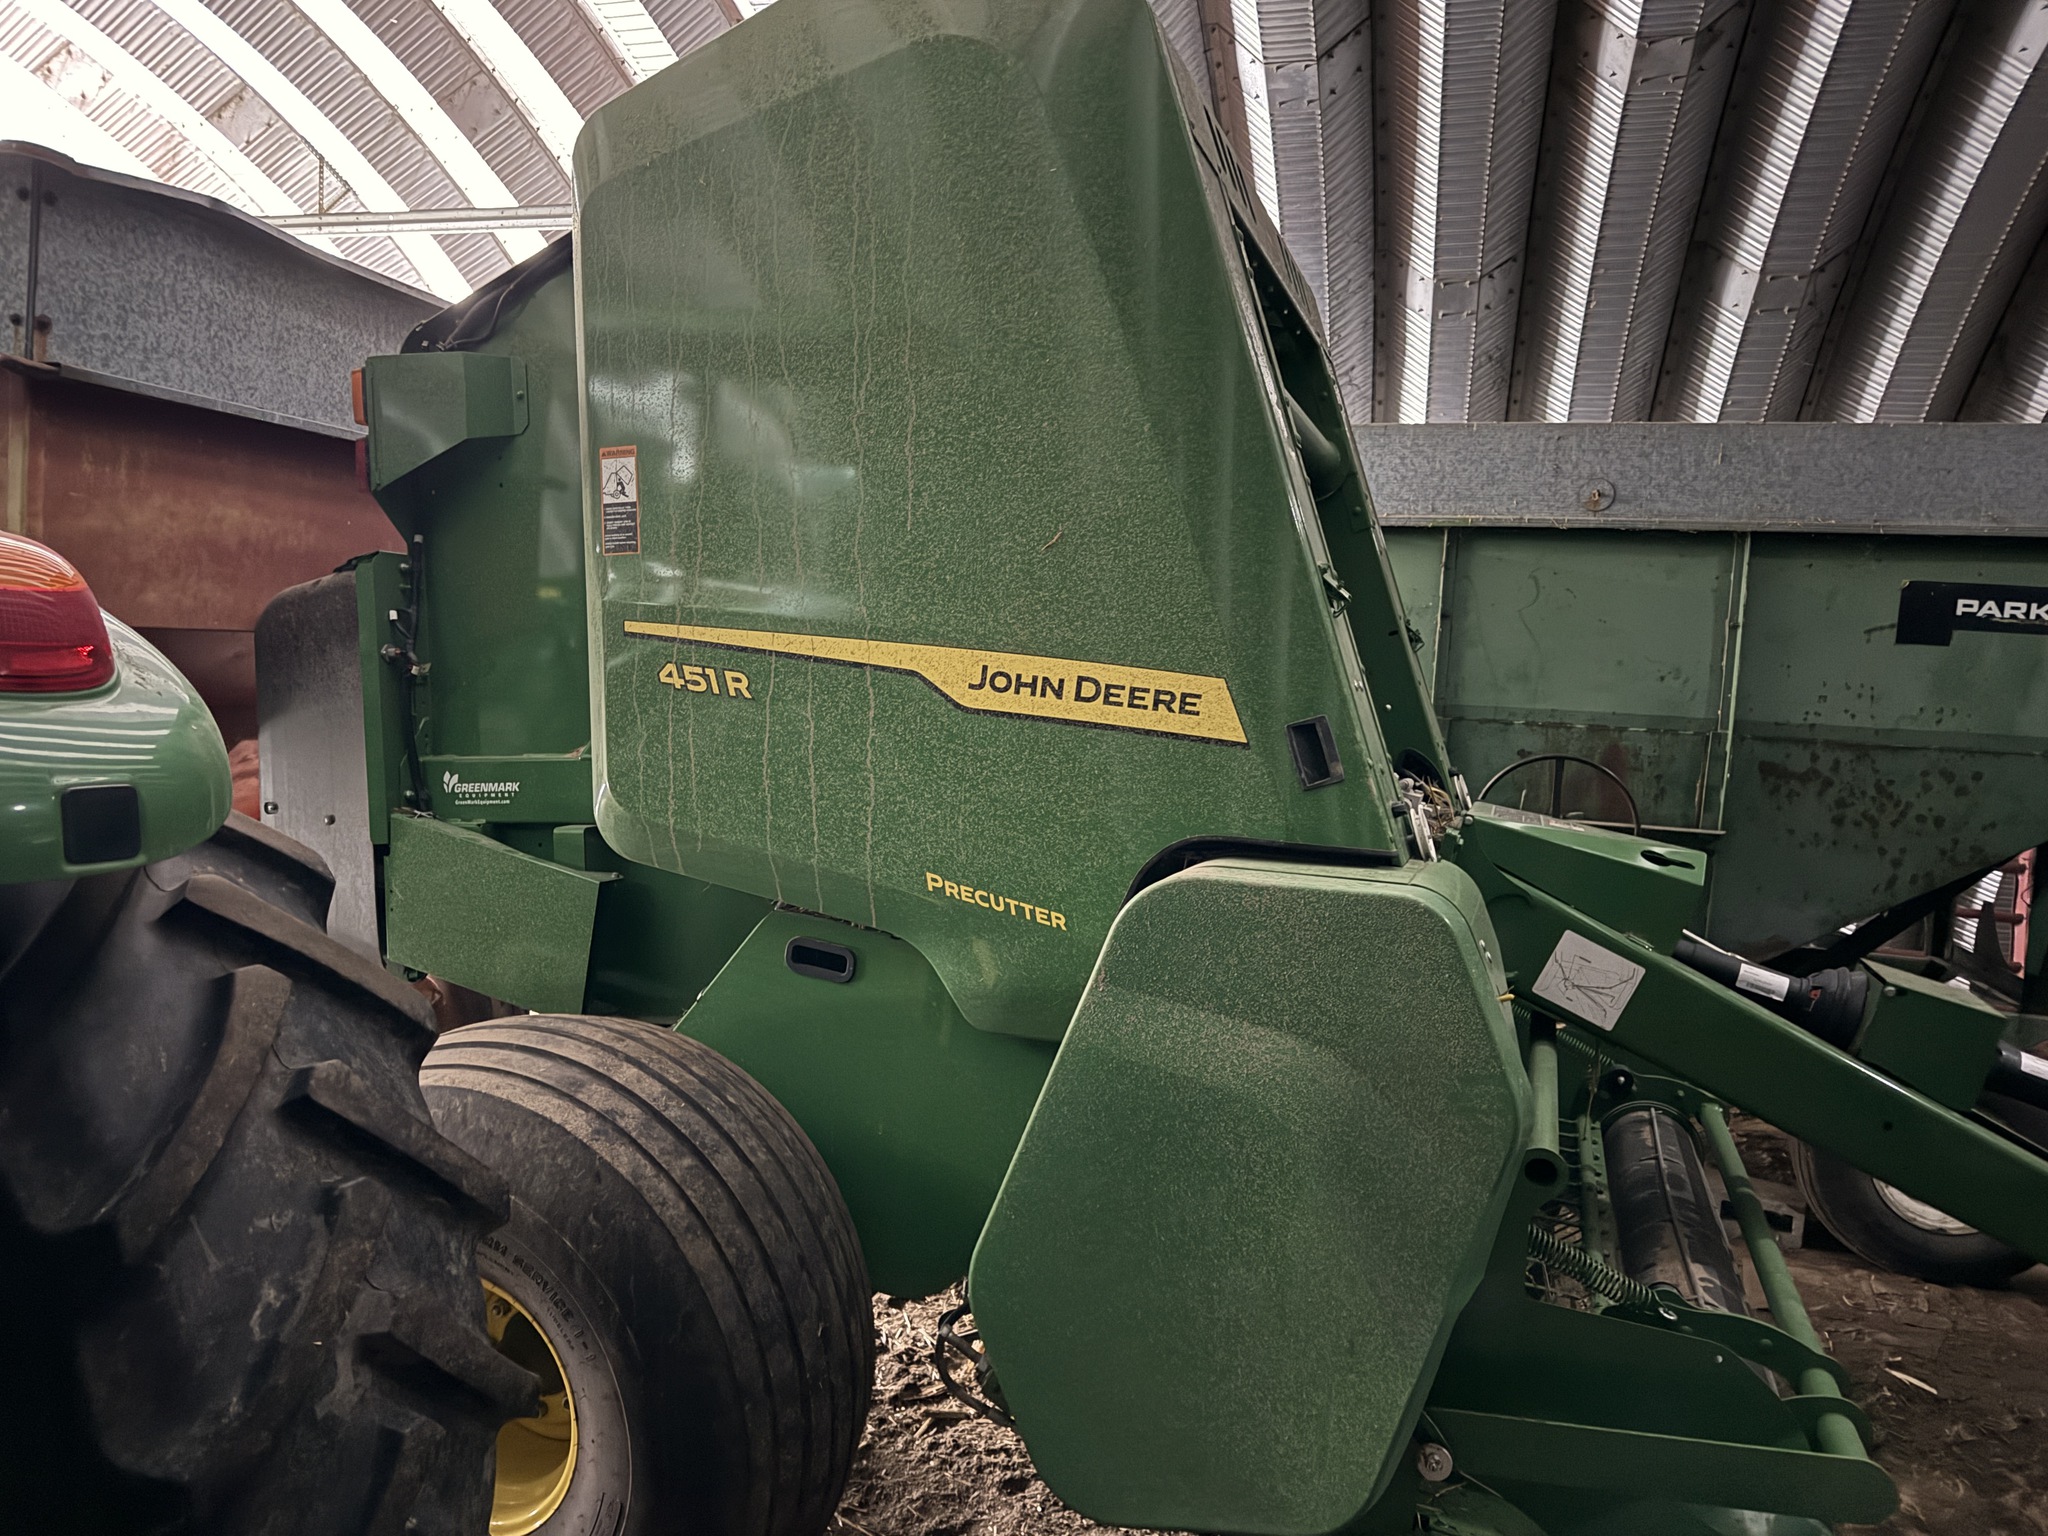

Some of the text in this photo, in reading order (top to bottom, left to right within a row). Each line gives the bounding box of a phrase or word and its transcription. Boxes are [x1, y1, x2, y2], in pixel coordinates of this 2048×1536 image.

[1955, 598, 2048, 620] PARK
[967, 664, 1203, 717] JOHN DEERE
[454, 782, 520, 793] GREENMARK
[925, 871, 1068, 932] PRECUTTER
